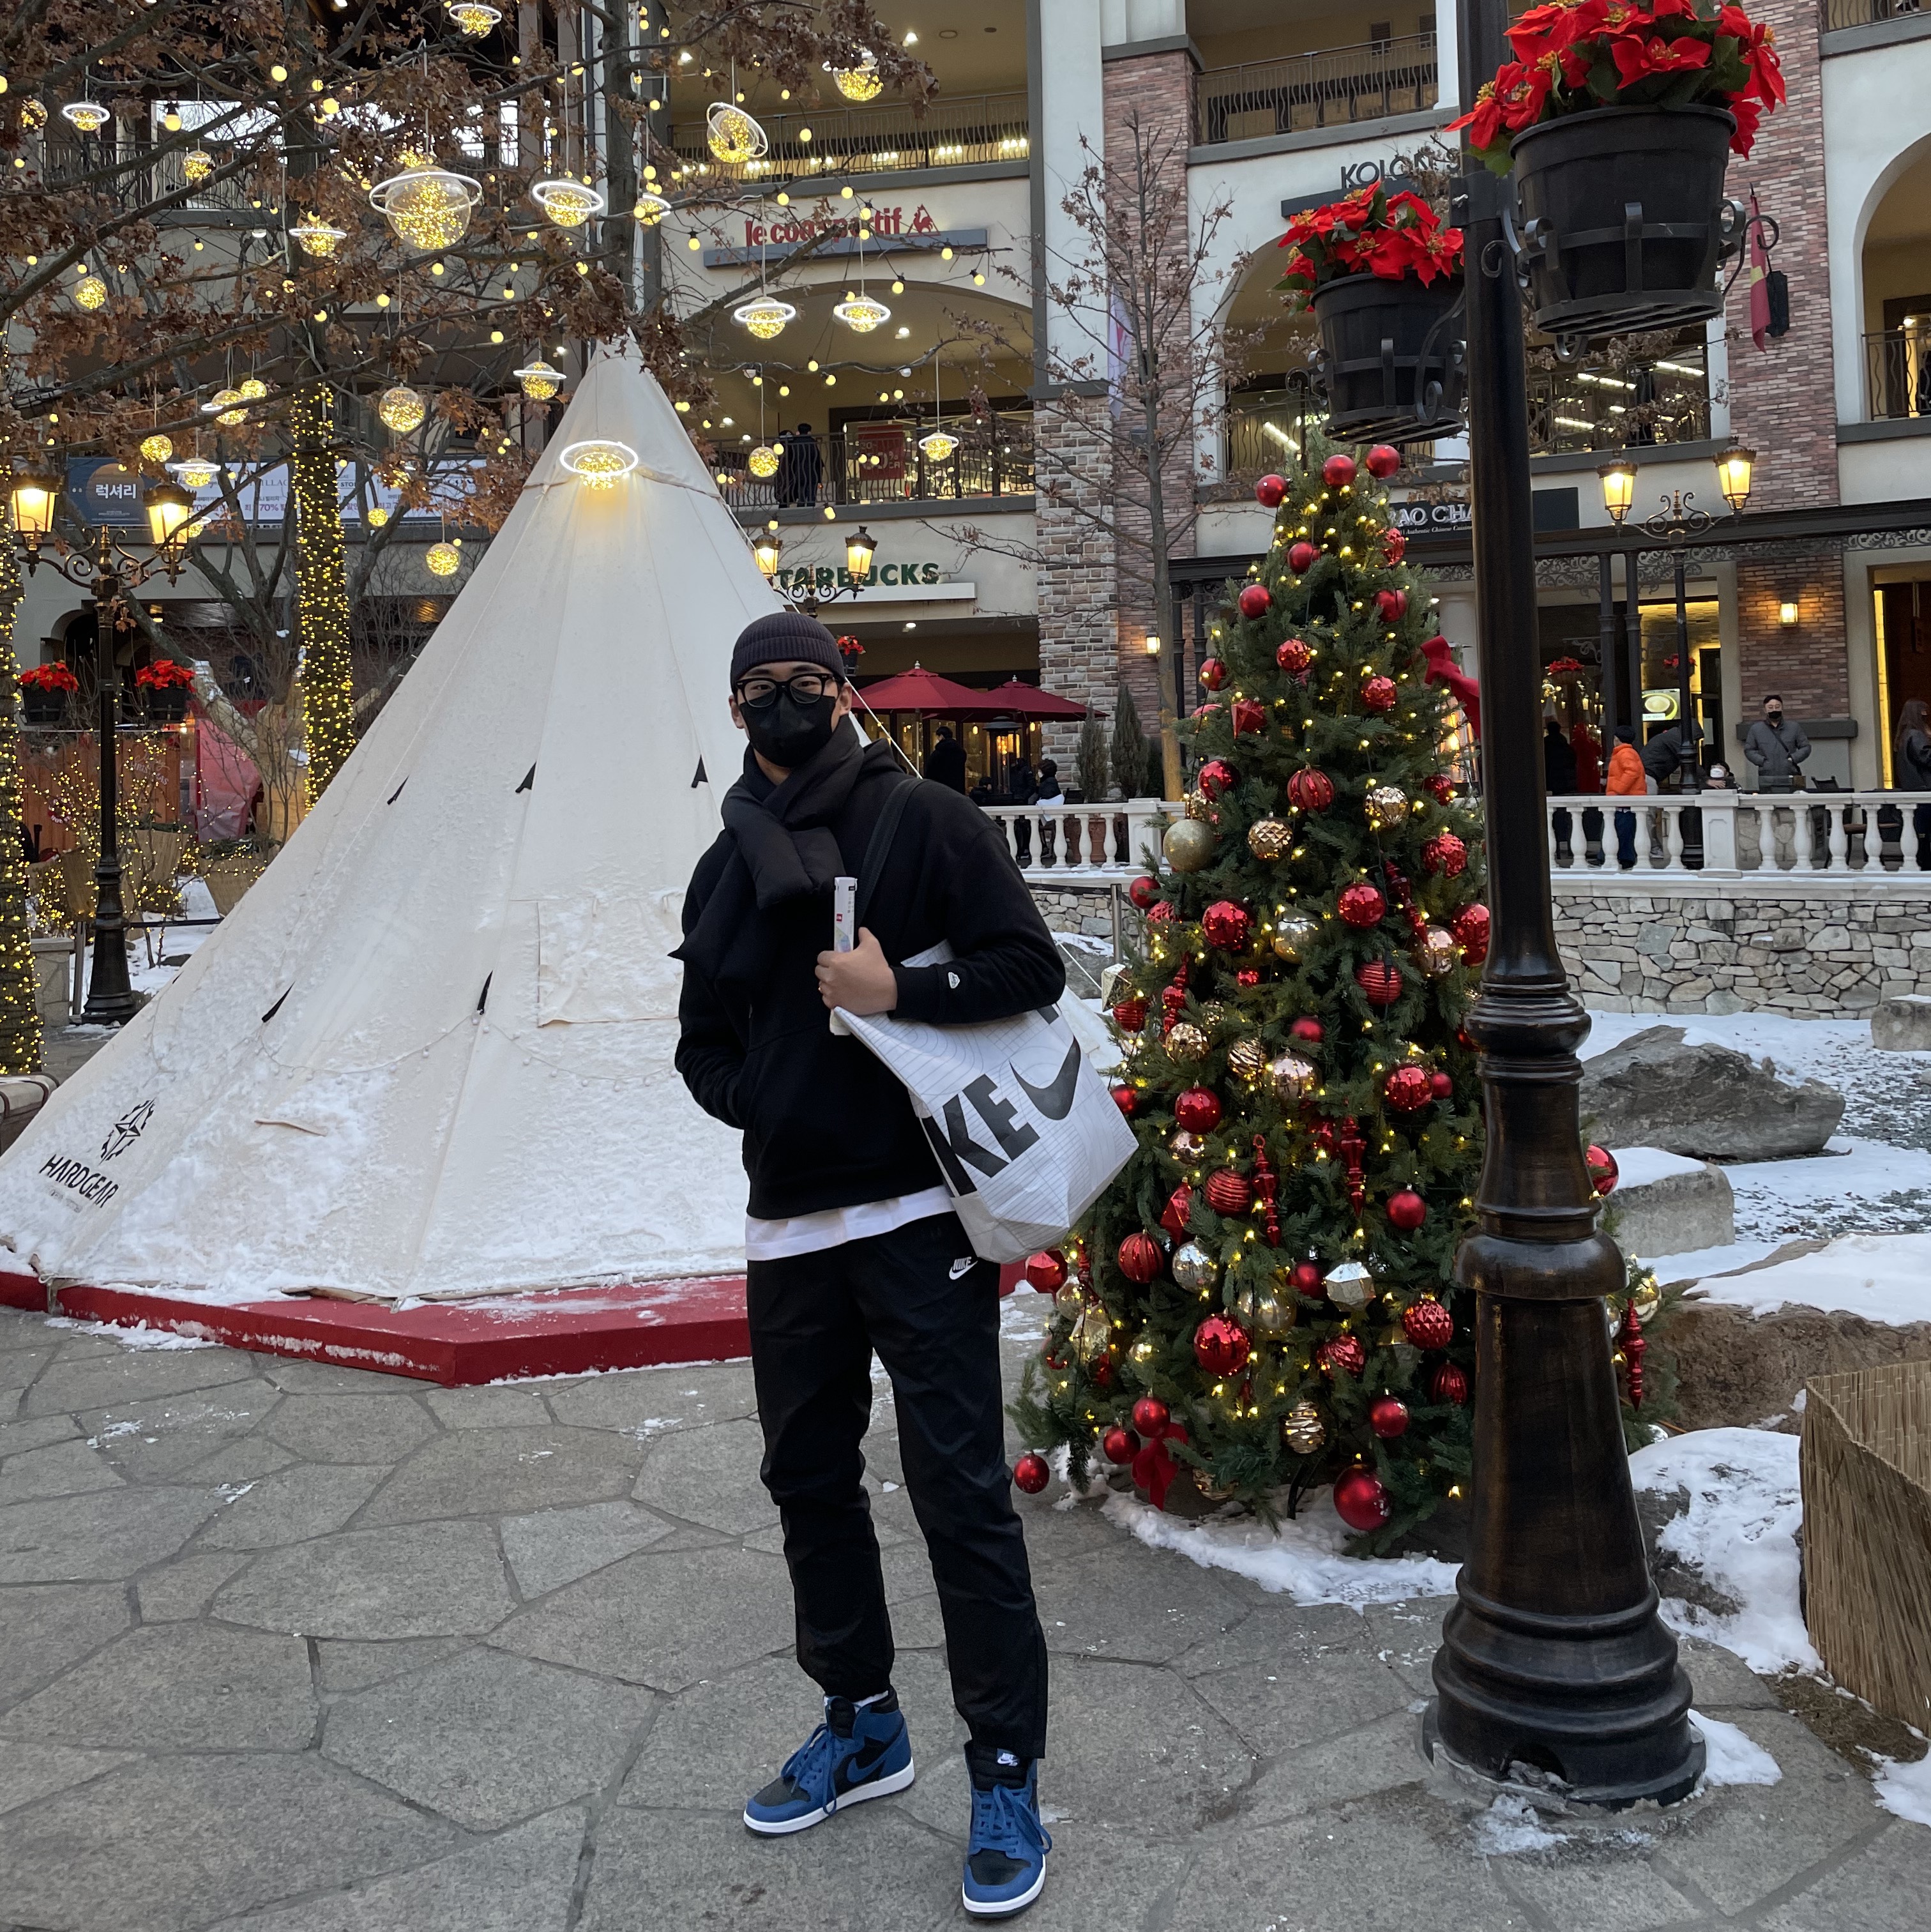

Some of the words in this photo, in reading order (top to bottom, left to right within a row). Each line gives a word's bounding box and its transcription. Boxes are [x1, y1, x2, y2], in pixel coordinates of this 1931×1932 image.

[1341, 152, 1436, 189] KOLON
[745, 220, 768, 247] le
[95, 483, 137, 499] 럭셔리
[259, 503, 279, 512] 70%
[777, 563, 939, 590] TARBUCKS
[38, 1153, 119, 1208] HARDGEAR
[953, 1256, 972, 1271] NIKE
